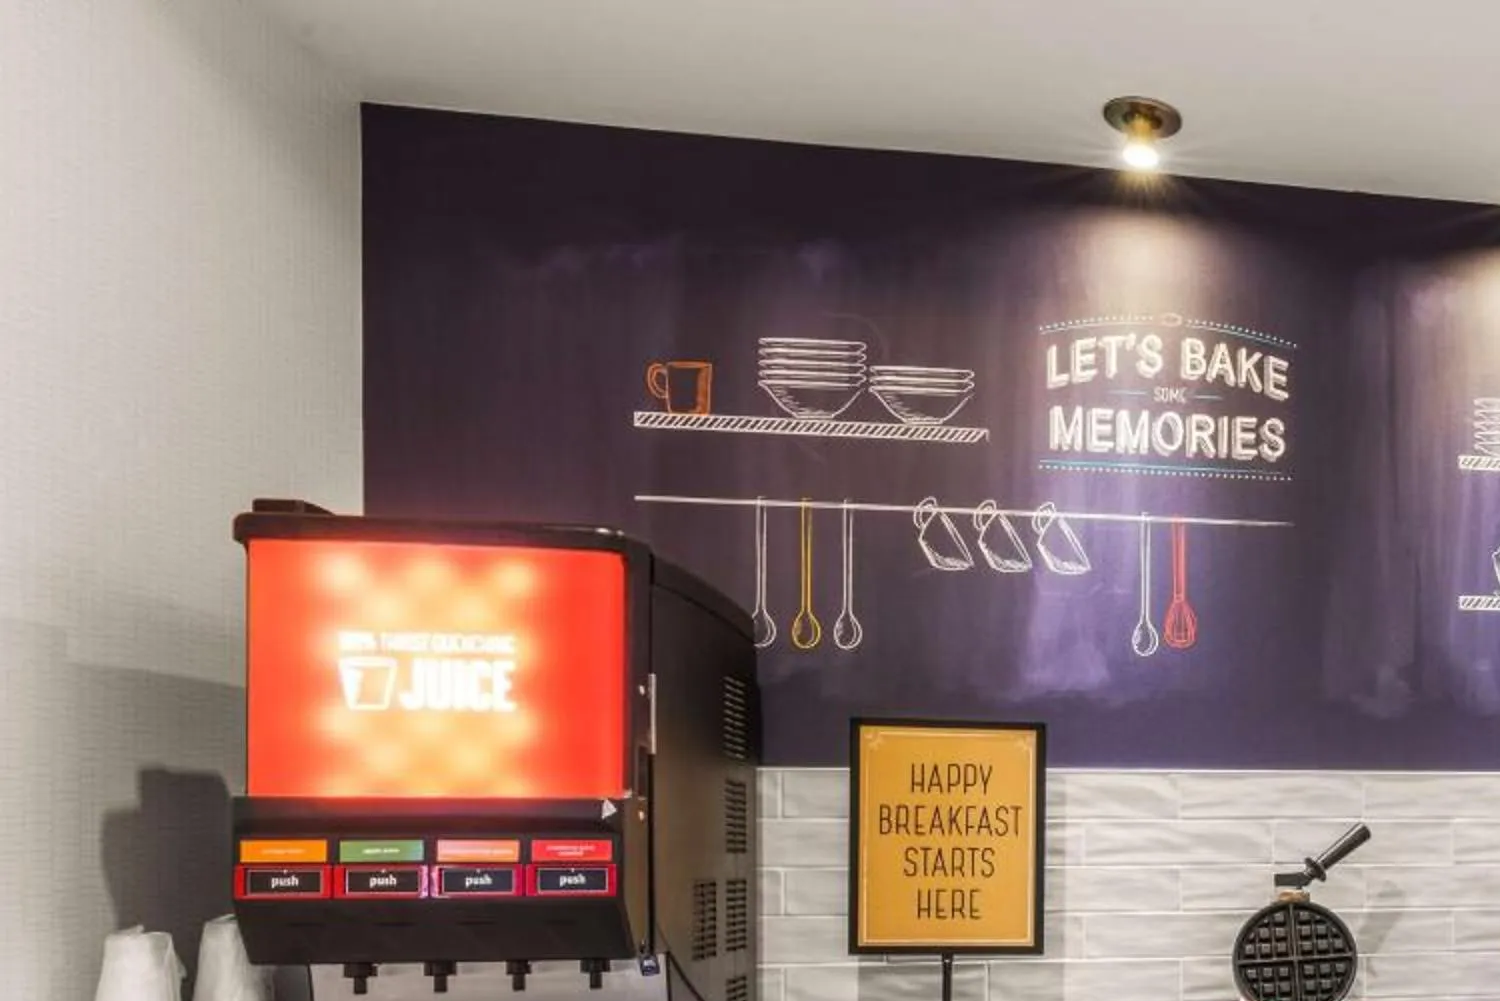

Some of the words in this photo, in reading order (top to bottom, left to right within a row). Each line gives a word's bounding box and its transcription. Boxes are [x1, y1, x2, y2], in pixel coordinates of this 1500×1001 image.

[1046, 332, 1165, 389] LET'S
[1180, 336, 1290, 401] BAKE
[1049, 405, 1286, 462] MEMORIES
[400, 659, 517, 712] JUICE
[910, 762, 993, 795] HAPPY
[879, 804, 1023, 838] BREAKFAST
[903, 847, 996, 879] STARTS
[271, 875, 299, 889] push
[369, 875, 397, 889] push
[465, 875, 493, 887] push
[559, 874, 586, 887] push
[917, 888, 982, 920] HERE
